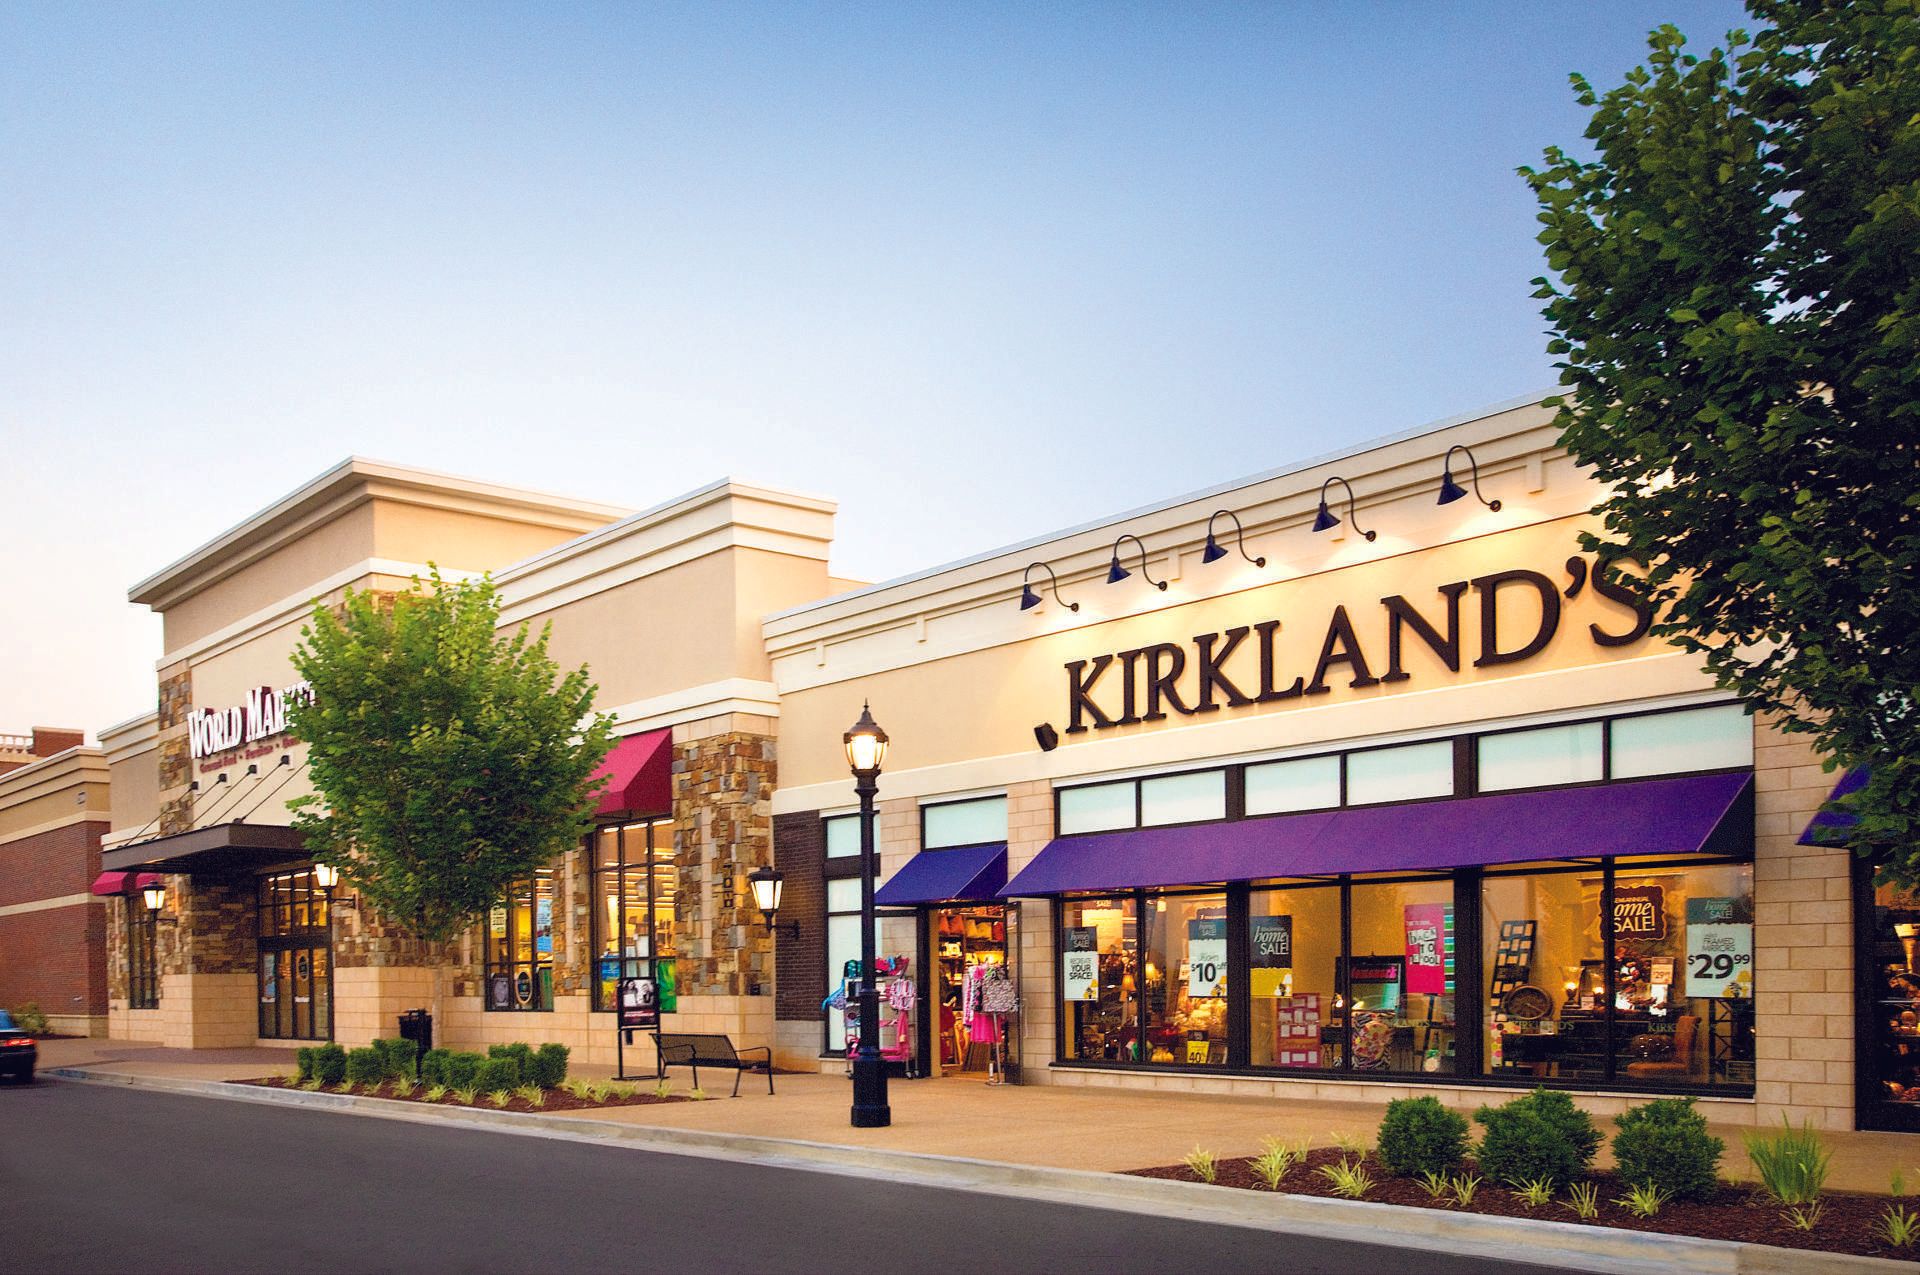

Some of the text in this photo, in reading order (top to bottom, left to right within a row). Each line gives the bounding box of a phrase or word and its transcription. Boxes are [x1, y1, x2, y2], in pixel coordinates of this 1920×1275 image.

[1064, 556, 1654, 734] KIRKLAND'S
[1614, 903, 1652, 917] ome
[1254, 926, 1287, 943] home
[1070, 964, 1092, 973] YOUR
[1191, 962, 1217, 982] $10
